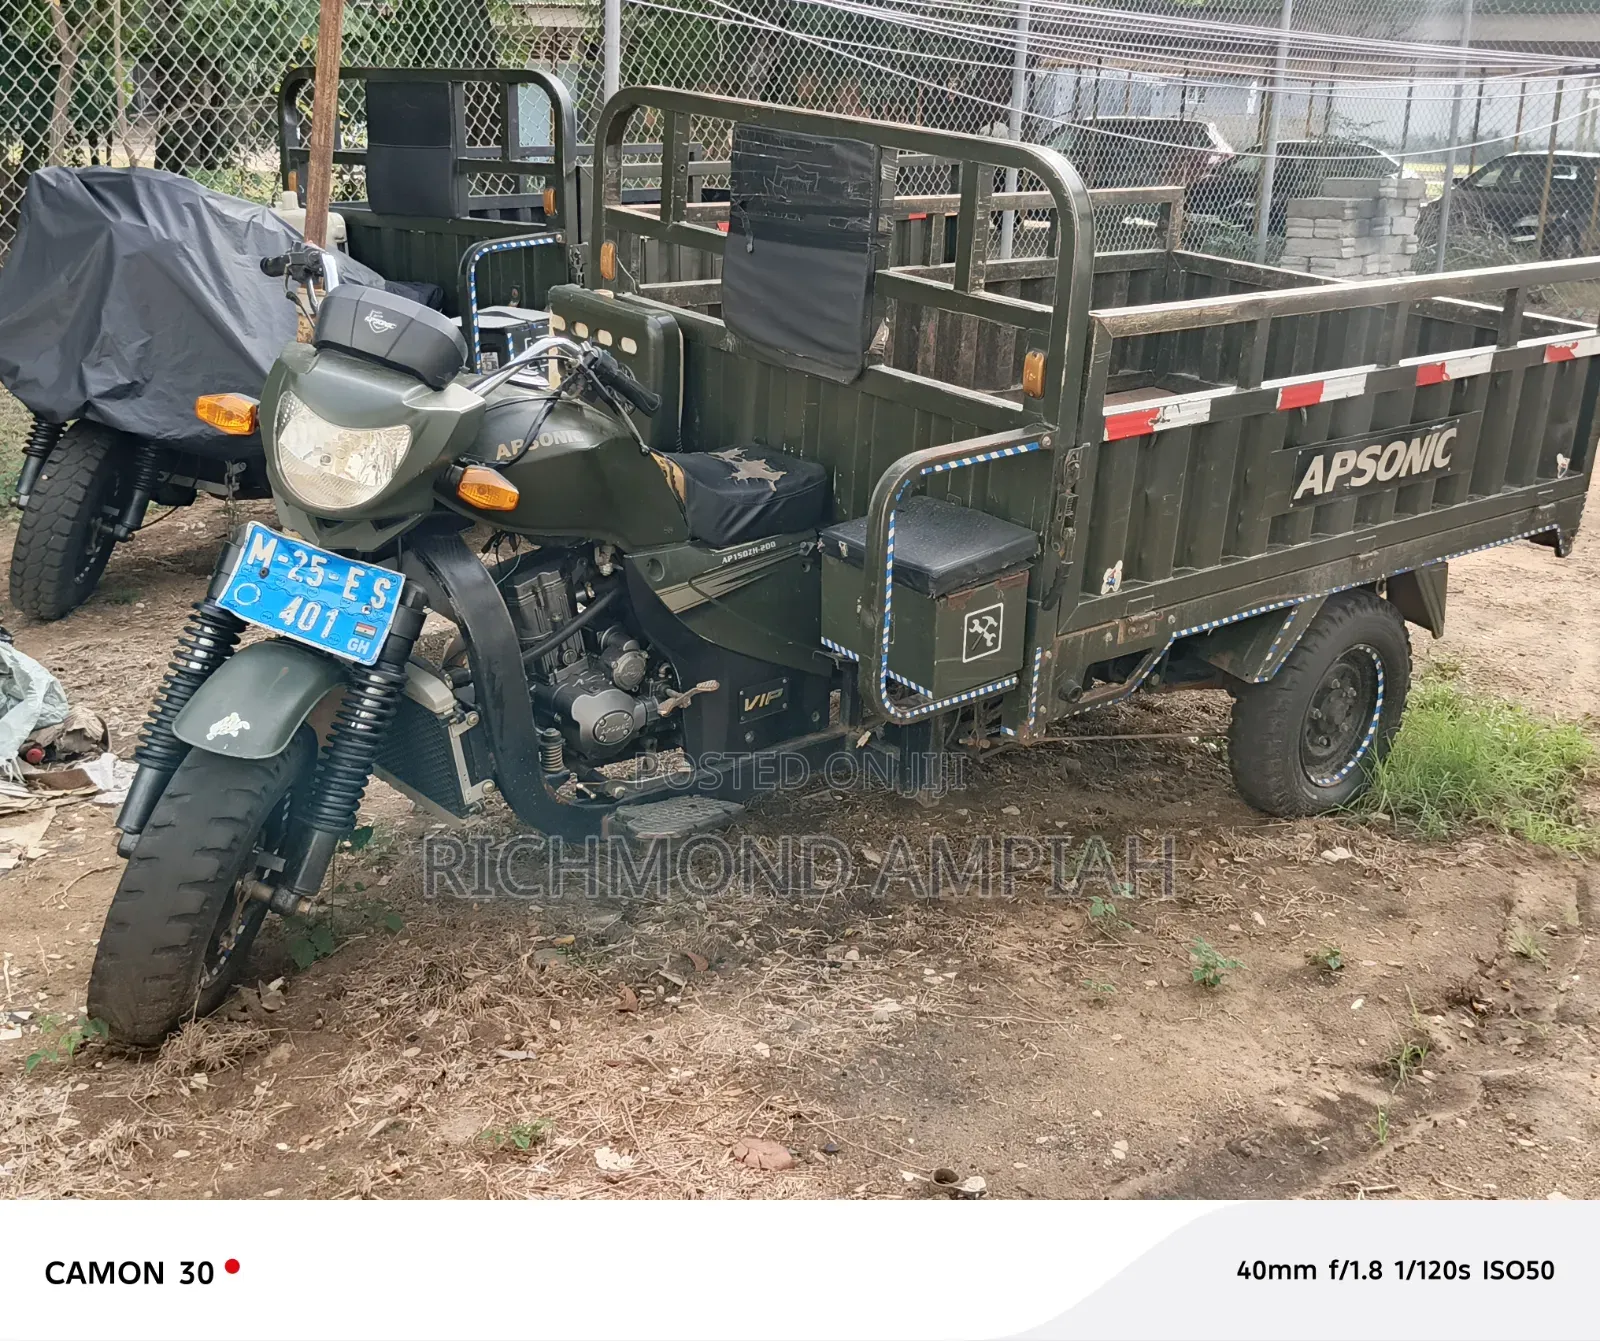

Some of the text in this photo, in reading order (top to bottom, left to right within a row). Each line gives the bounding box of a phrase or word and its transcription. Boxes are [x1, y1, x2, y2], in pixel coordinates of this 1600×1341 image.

[1293, 428, 1457, 500] APSONIC
[279, 596, 339, 638] 401
[347, 638, 370, 654] GH
[744, 688, 784, 711] VIP
